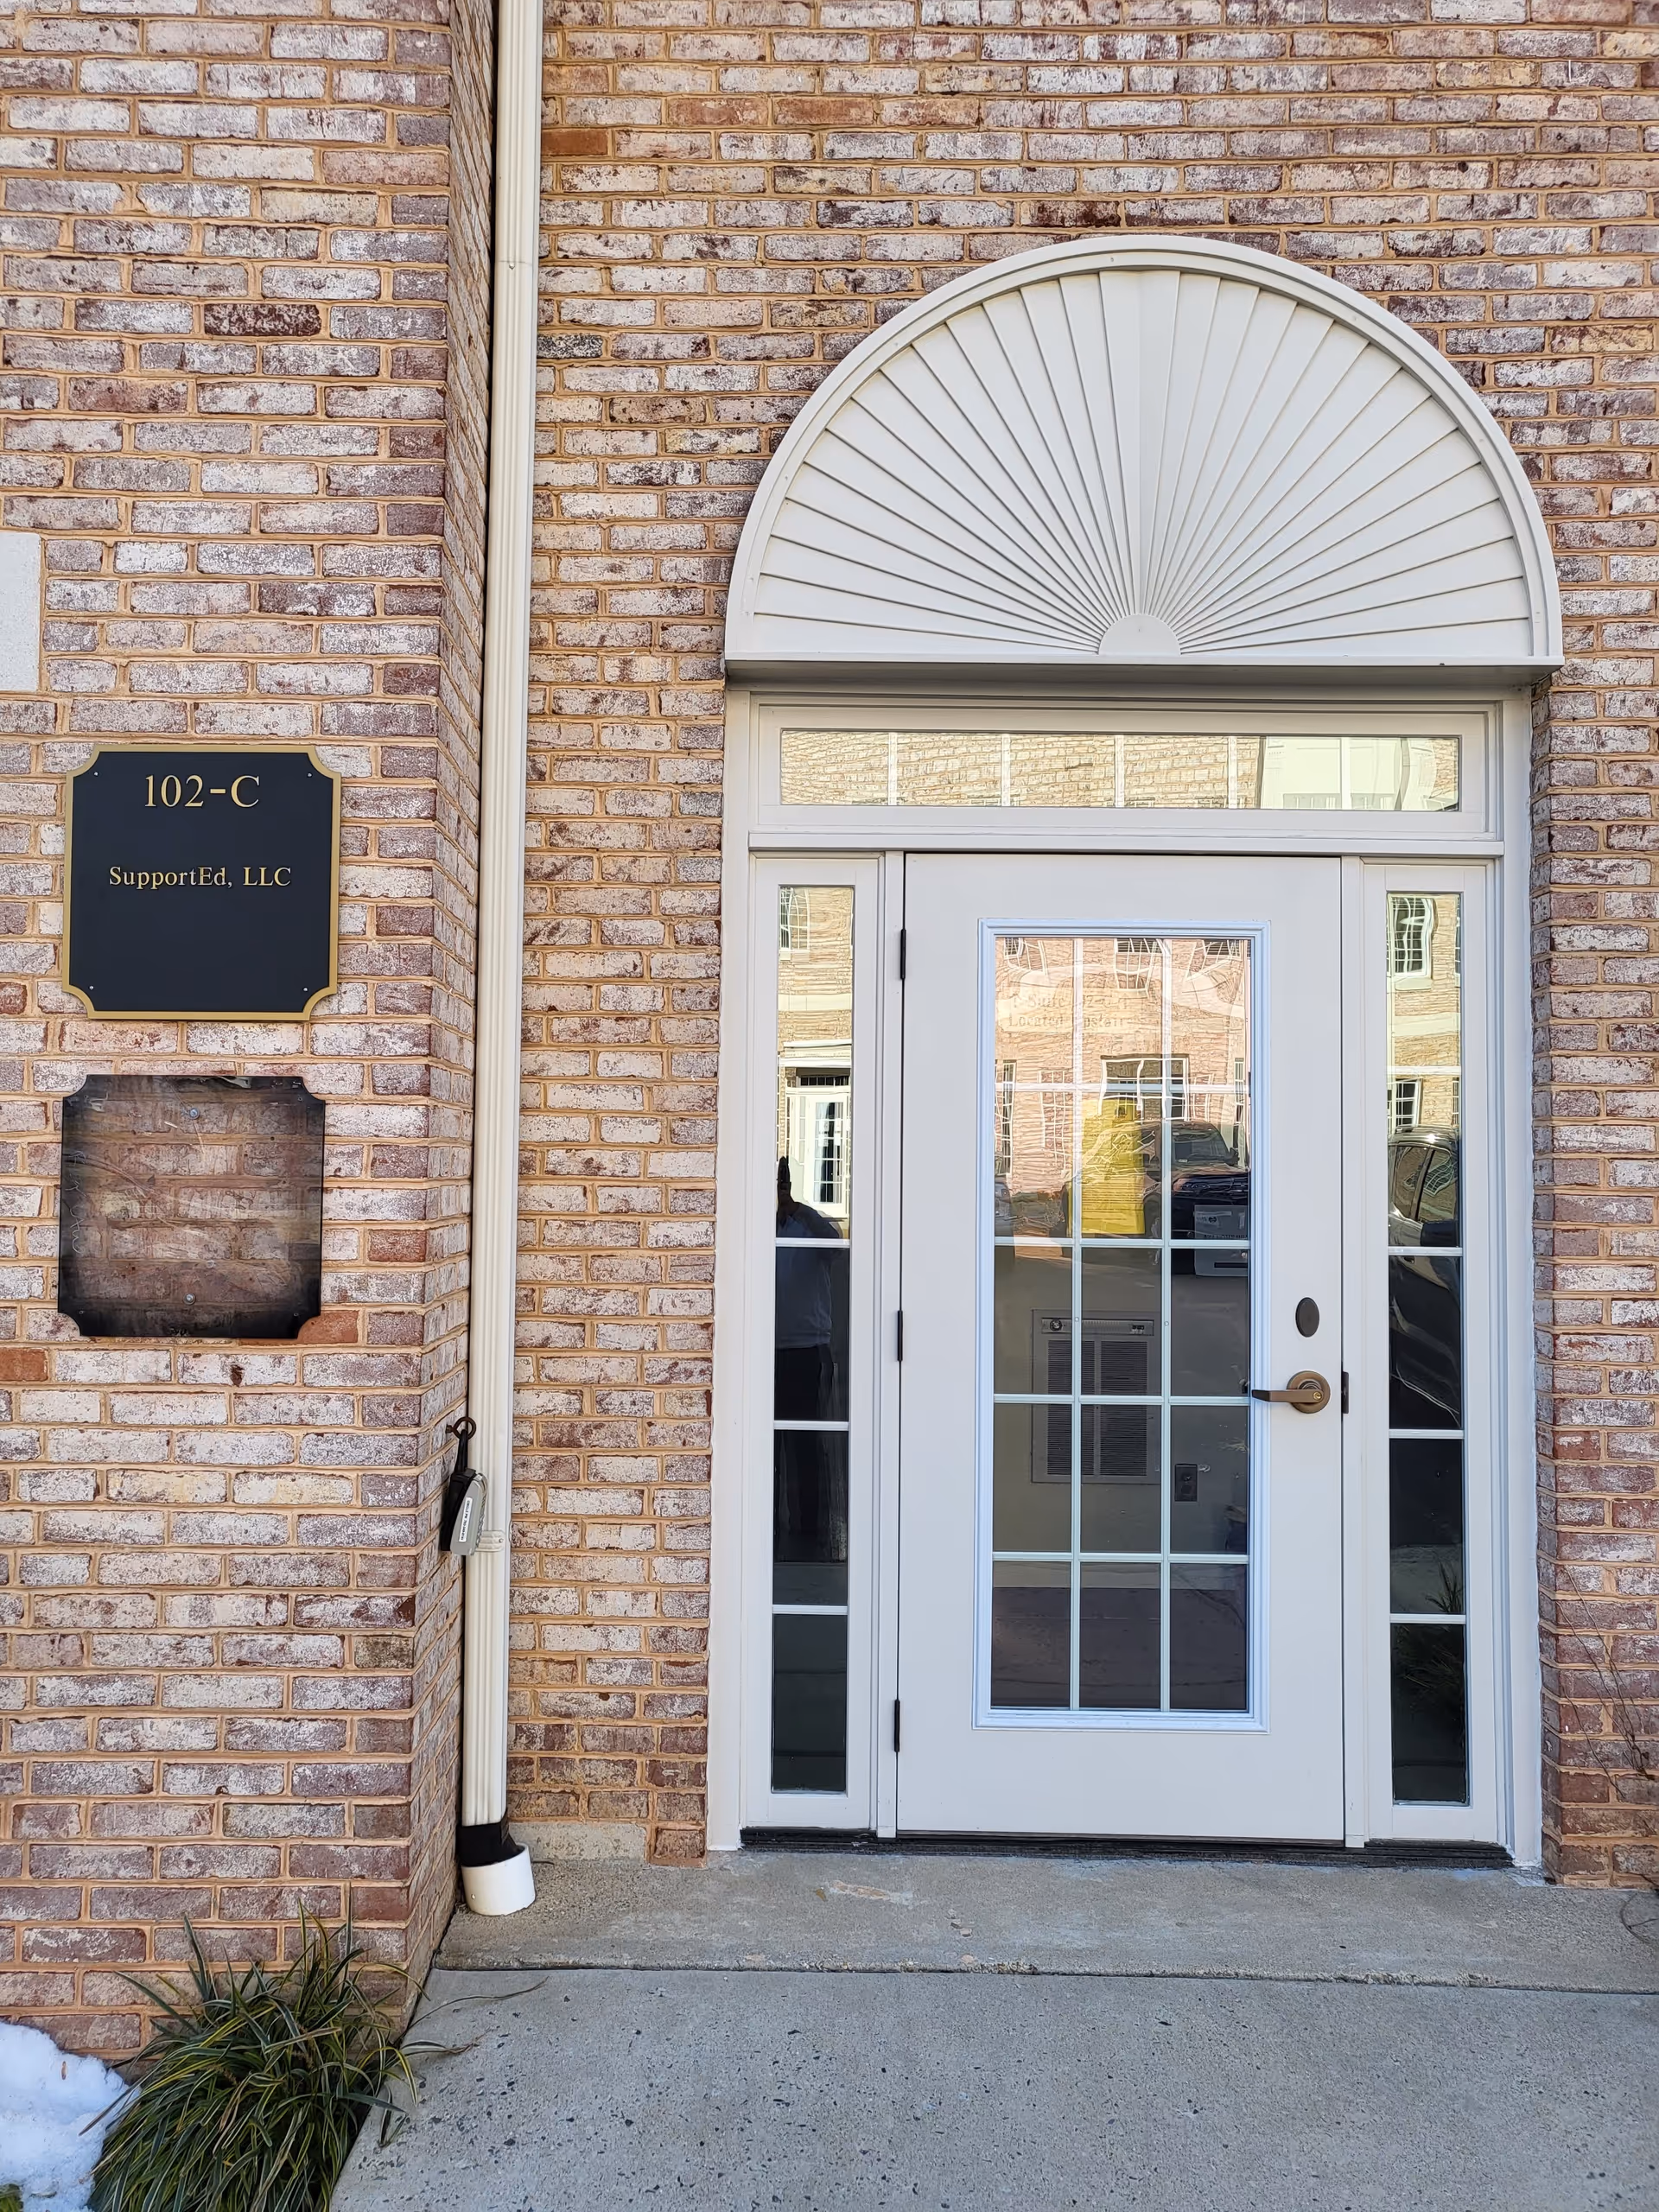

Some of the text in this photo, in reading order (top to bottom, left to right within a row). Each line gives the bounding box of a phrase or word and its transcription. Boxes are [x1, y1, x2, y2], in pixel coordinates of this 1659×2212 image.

[145, 775, 259, 808] 102-C
[109, 866, 292, 890] SupportEd, LLC
